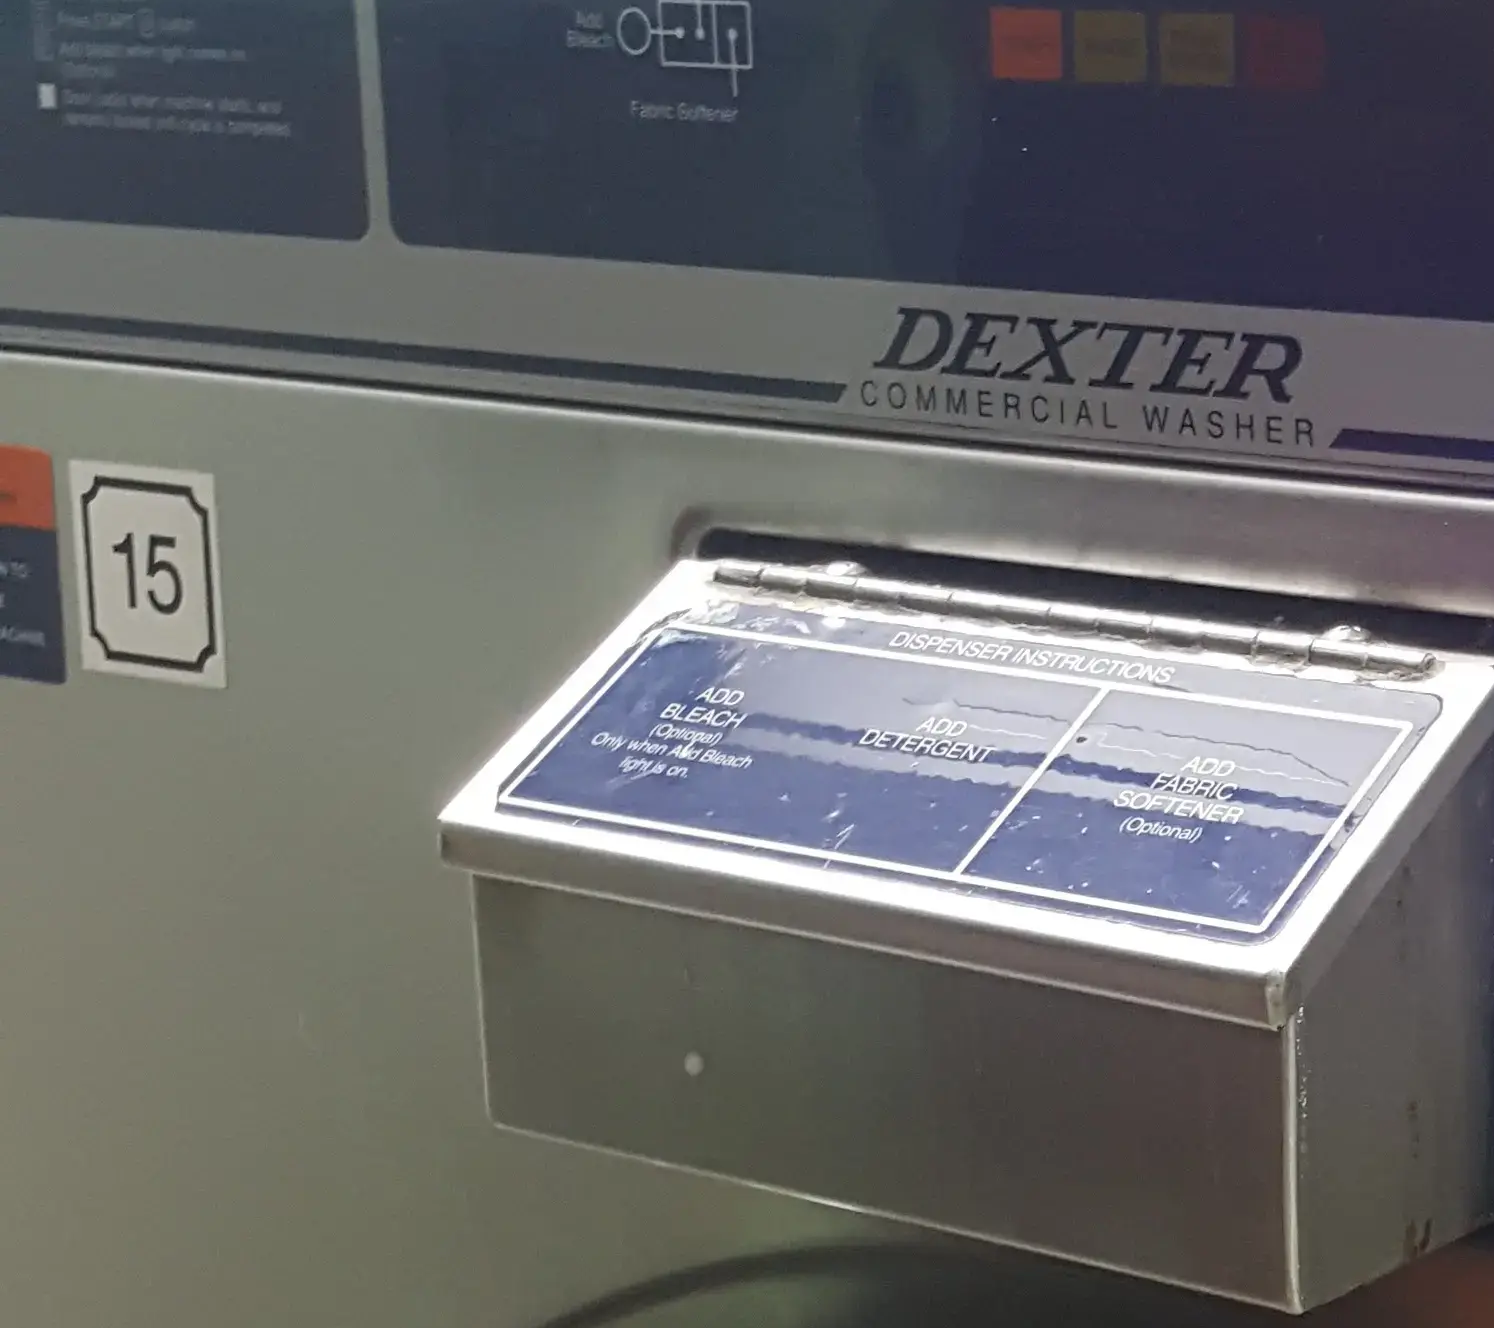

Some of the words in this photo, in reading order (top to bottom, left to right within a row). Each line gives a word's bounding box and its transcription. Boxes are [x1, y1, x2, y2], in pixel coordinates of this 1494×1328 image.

[872, 306, 1304, 404] DEXTER
[859, 379, 1119, 430] COMMERCIAL
[1141, 403, 1316, 448] WASHER
[111, 531, 184, 616] 15
[888, 630, 1014, 662] DISPENSER
[1011, 646, 1177, 685] INSTRUCTIONS
[694, 685, 746, 706] ADD
[658, 702, 749, 729] BLEACH
[915, 716, 968, 738] ADD
[648, 722, 725, 746] (Optional)
[858, 727, 999, 765] DETERGENT
[590, 730, 628, 752] Only
[626, 738, 670, 757] when
[699, 748, 754, 770] Bleach
[664, 765, 690, 779] on.
[1179, 755, 1238, 777] ADD
[1149, 771, 1239, 801] FABRIC
[1112, 788, 1245, 825] SOFTENER
[1118, 815, 1204, 844] (Optional)
